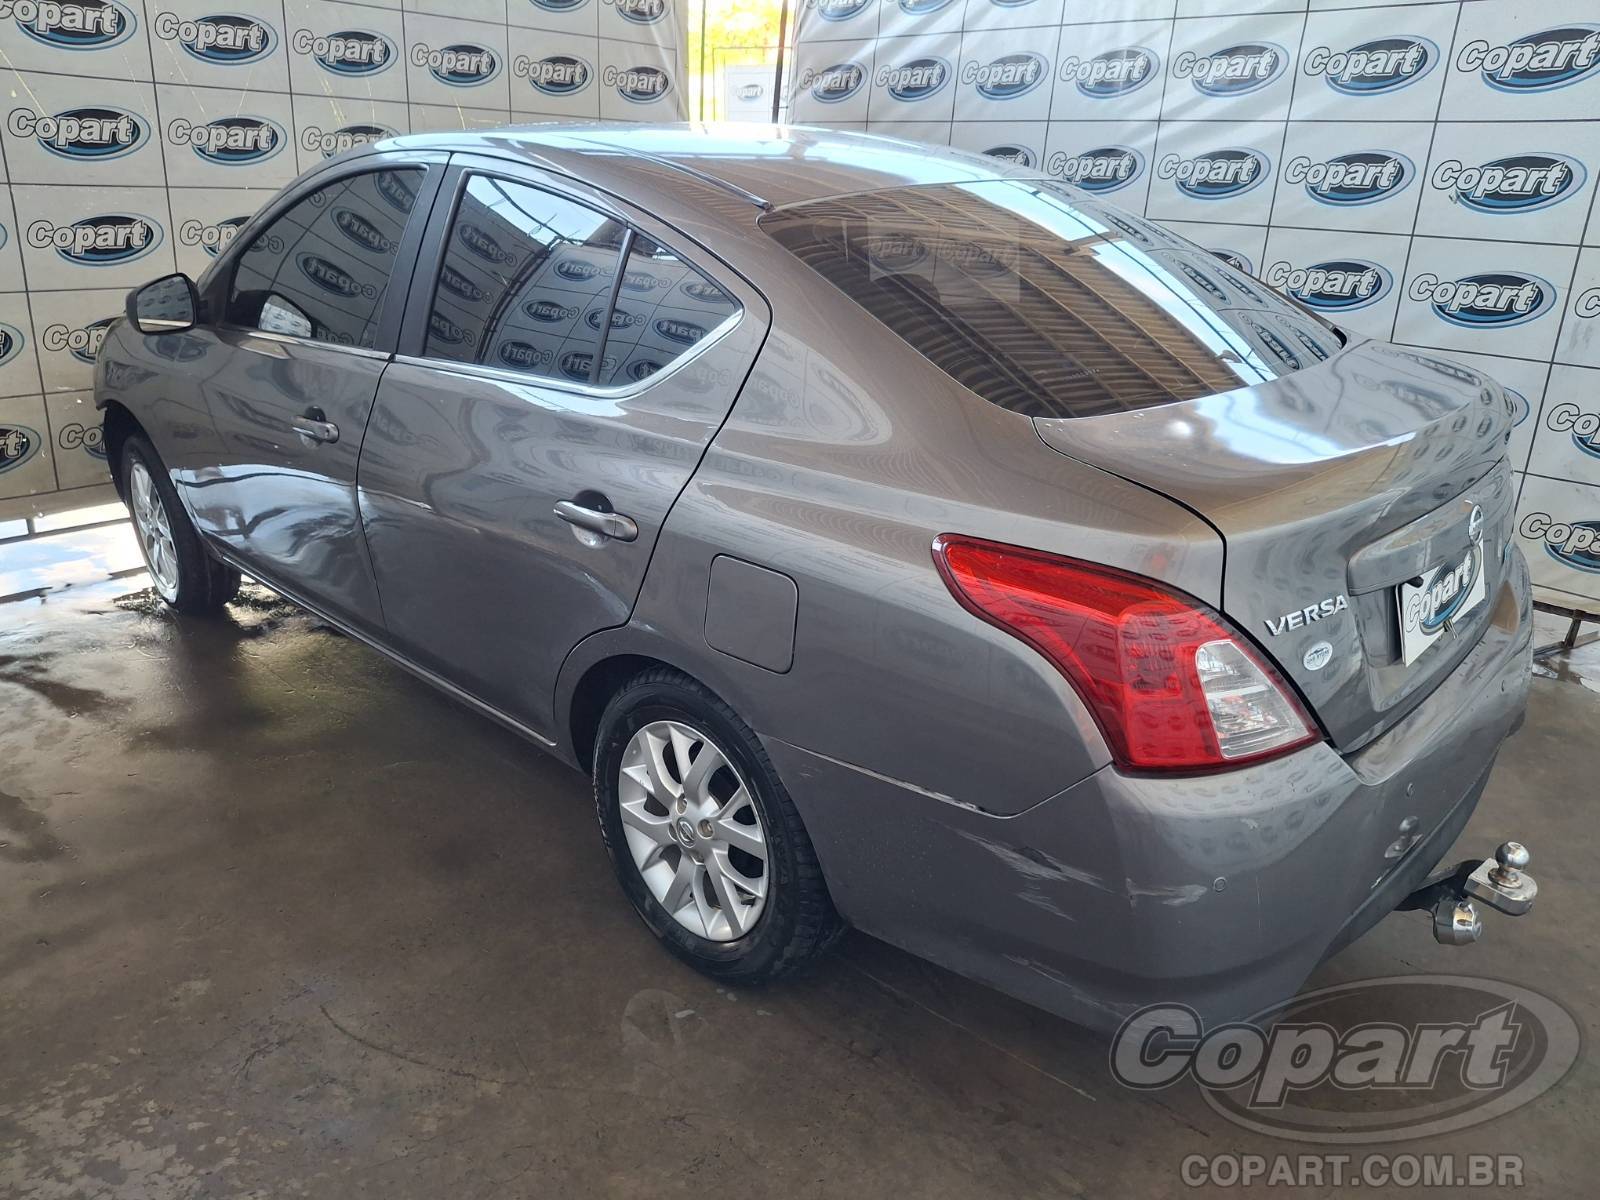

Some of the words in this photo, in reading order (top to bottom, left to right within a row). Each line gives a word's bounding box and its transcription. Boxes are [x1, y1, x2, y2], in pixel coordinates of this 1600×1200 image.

[155, 12, 263, 51] Copart
[293, 29, 385, 64] Copart
[411, 43, 491, 75] Copart
[513, 55, 584, 85] Copart
[962, 59, 1039, 90] Copart
[1060, 52, 1149, 88] Copart
[1173, 49, 1278, 87] Copart
[1304, 43, 1422, 82] Copart
[1457, 33, 1600, 80] Copart
[603, 65, 669, 93] Copart
[801, 63, 861, 93] Copart
[875, 59, 945, 91] Copart
[7, 107, 135, 147] Copart
[168, 119, 273, 152] Copart
[1047, 151, 1134, 182] Copart
[1158, 153, 1257, 187] Copart
[1285, 156, 1400, 193] Copart
[1432, 160, 1568, 199] Copart
[27, 219, 147, 256] Copart
[1266, 261, 1378, 297] Copart
[1409, 273, 1541, 313] Copart
[1406, 550, 1472, 632] Copart
[1264, 595, 1348, 636] VERSA
